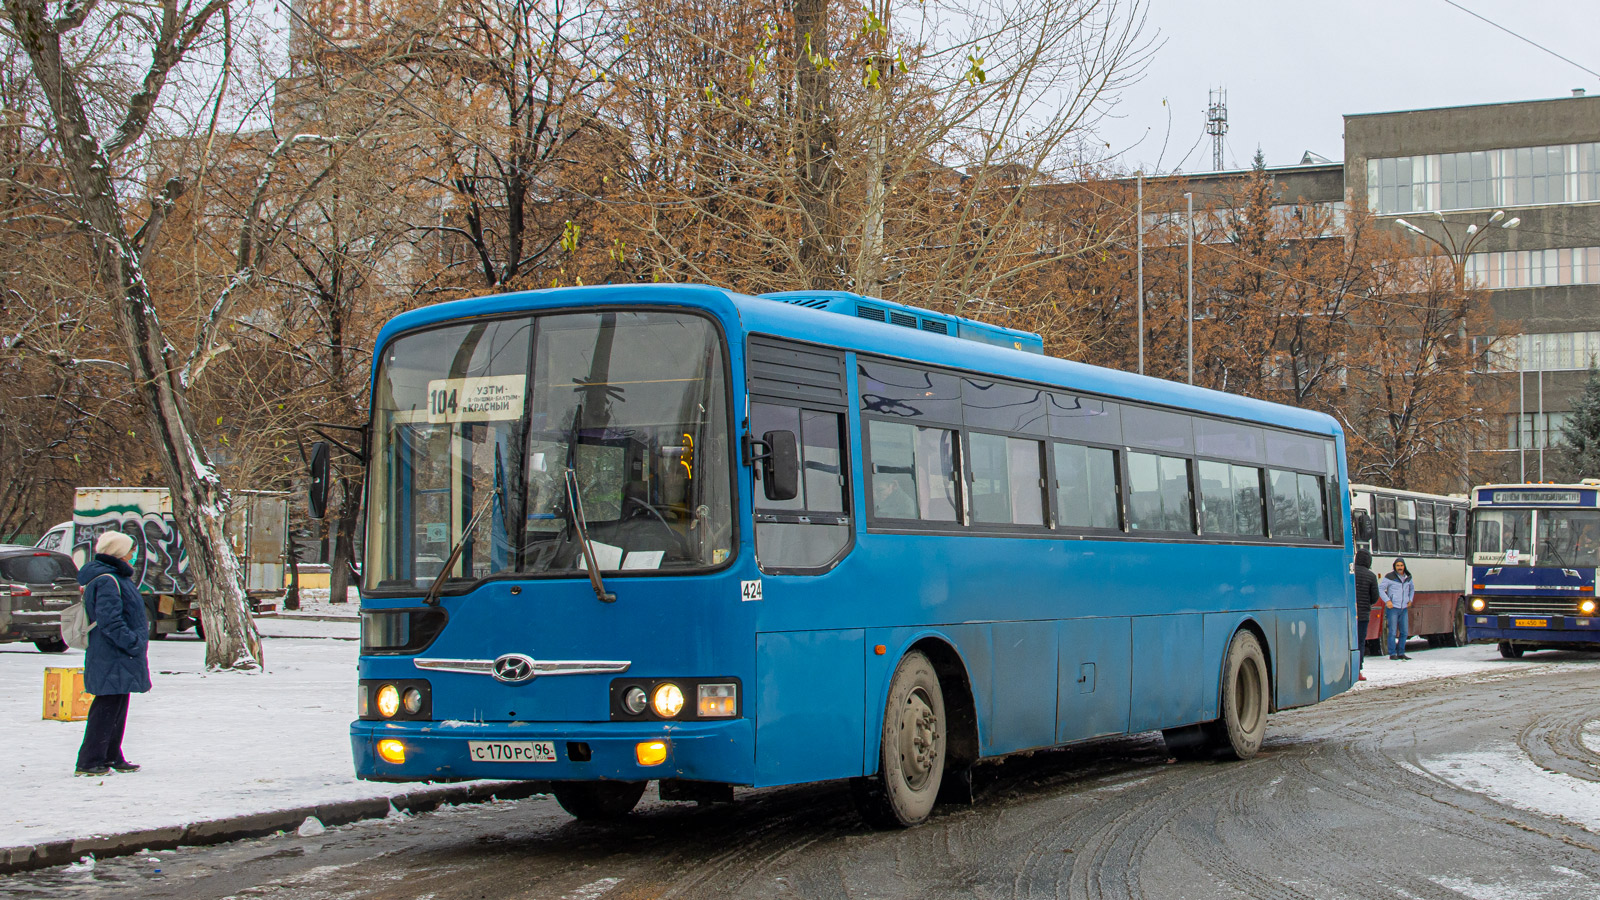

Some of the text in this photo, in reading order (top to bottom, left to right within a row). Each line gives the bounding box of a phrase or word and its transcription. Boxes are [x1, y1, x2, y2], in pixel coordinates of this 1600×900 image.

[430, 388, 458, 415] 104
[743, 582, 762, 599] 424
[534, 743, 550, 756] 96
